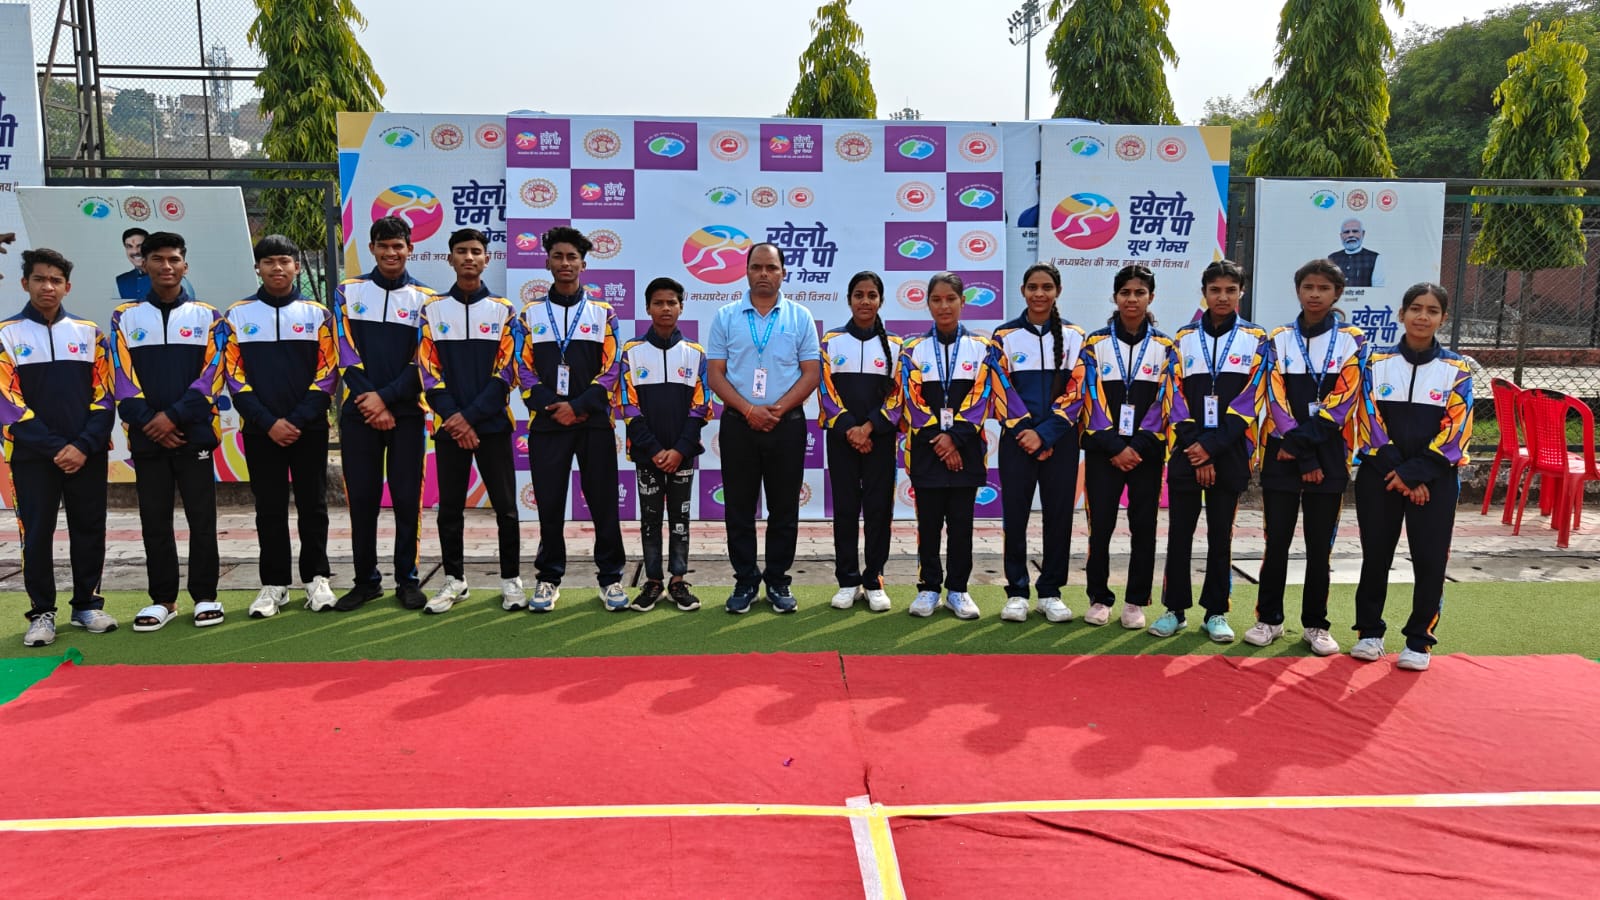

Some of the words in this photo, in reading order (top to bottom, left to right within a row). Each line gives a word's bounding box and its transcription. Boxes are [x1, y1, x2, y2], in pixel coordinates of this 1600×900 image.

[452, 179, 506, 206] खेलो
[1130, 190, 1187, 216] खेलो
[454, 205, 493, 225] एम
[1130, 215, 1168, 235] एम
[1171, 211, 1195, 236] पी
[766, 221, 828, 247] खेलो
[783, 247, 806, 267] म
[811, 241, 838, 267] पी
[1127, 240, 1152, 256] यूथ
[1155, 237, 1189, 253] गेम्स
[1056, 257, 1092, 267] मध्यप्रदेश
[1093, 256, 1104, 267] की
[1150, 258, 1161, 267] की
[797, 268, 831, 283] गेम्स
[690, 290, 729, 301] मध्यप्रदेश
[731, 290, 742, 301] की
[795, 291, 806, 301] की
[1352, 305, 1393, 327] खेलो
[1361, 327, 1379, 343] म
[1381, 321, 1399, 343] पी
